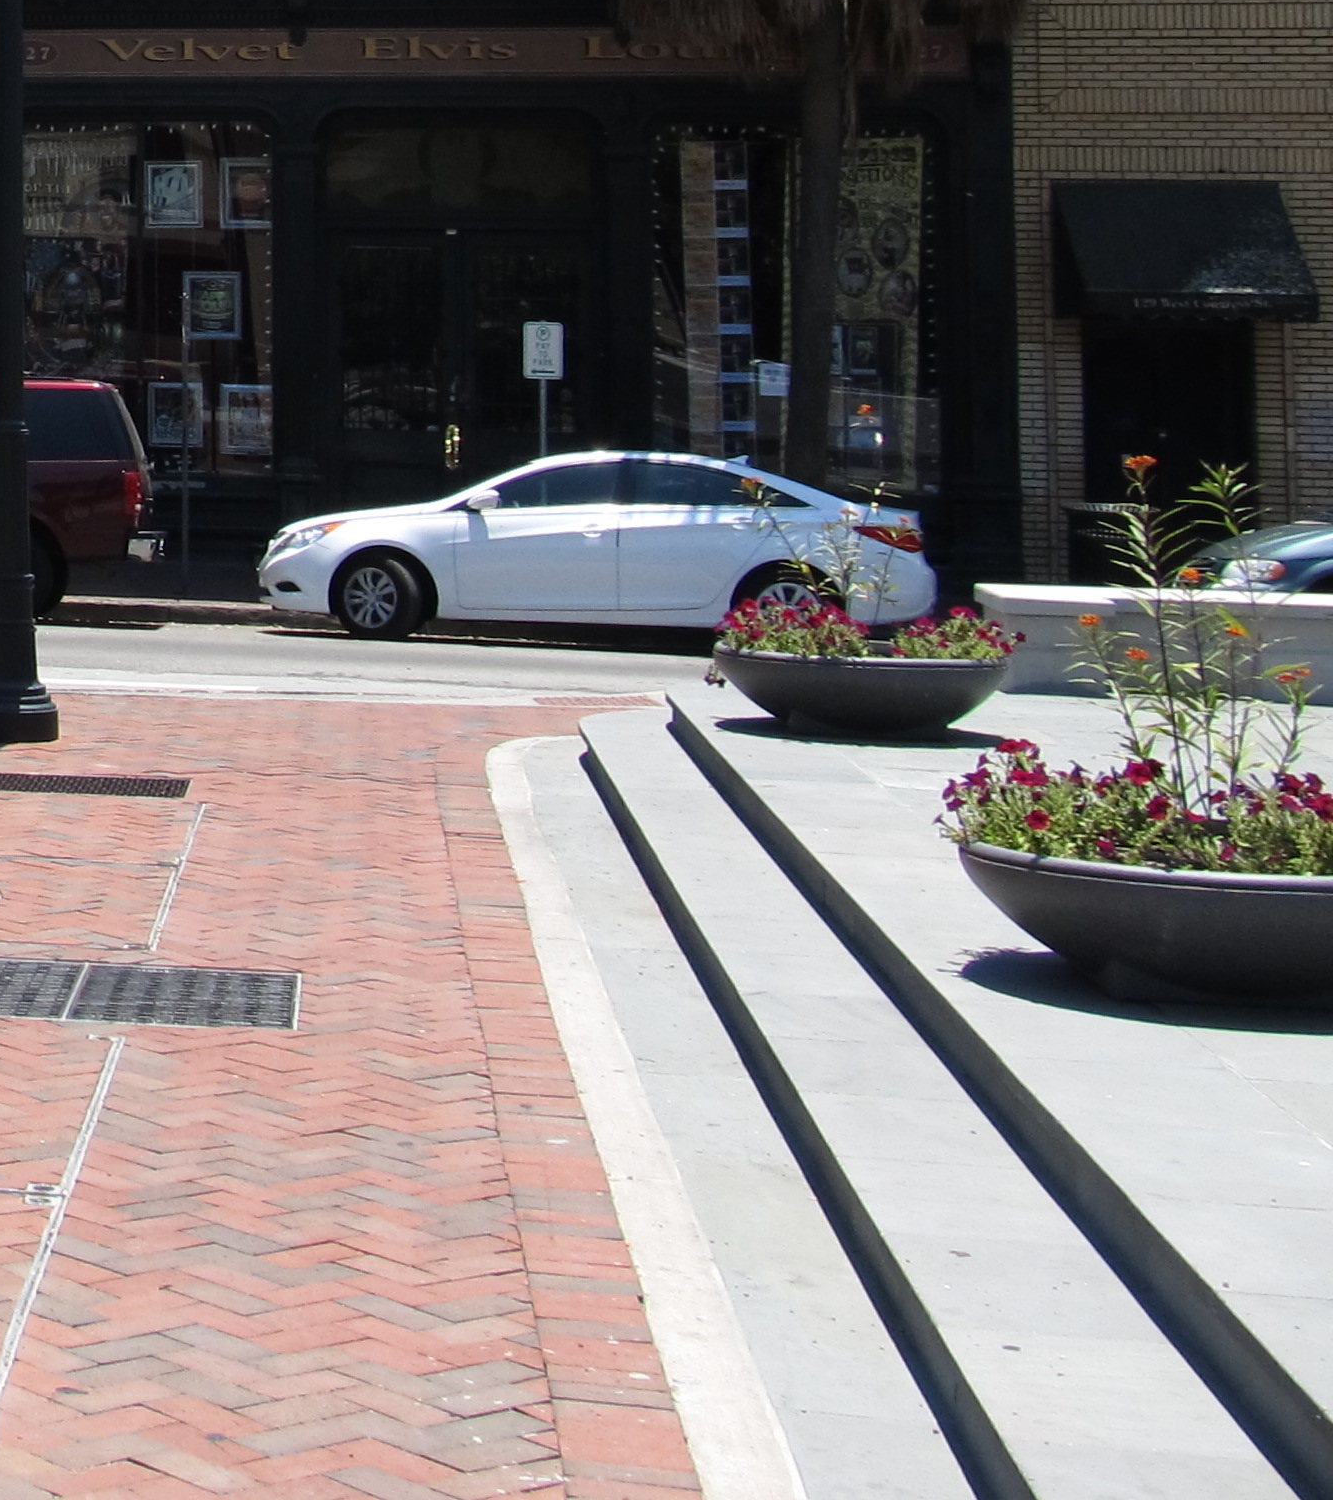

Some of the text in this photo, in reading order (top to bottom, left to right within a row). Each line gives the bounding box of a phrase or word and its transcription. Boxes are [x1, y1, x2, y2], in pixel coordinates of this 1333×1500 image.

[24, 46, 51, 61] 27
[98, 38, 304, 61] Velvet
[358, 36, 517, 61] Elvis
